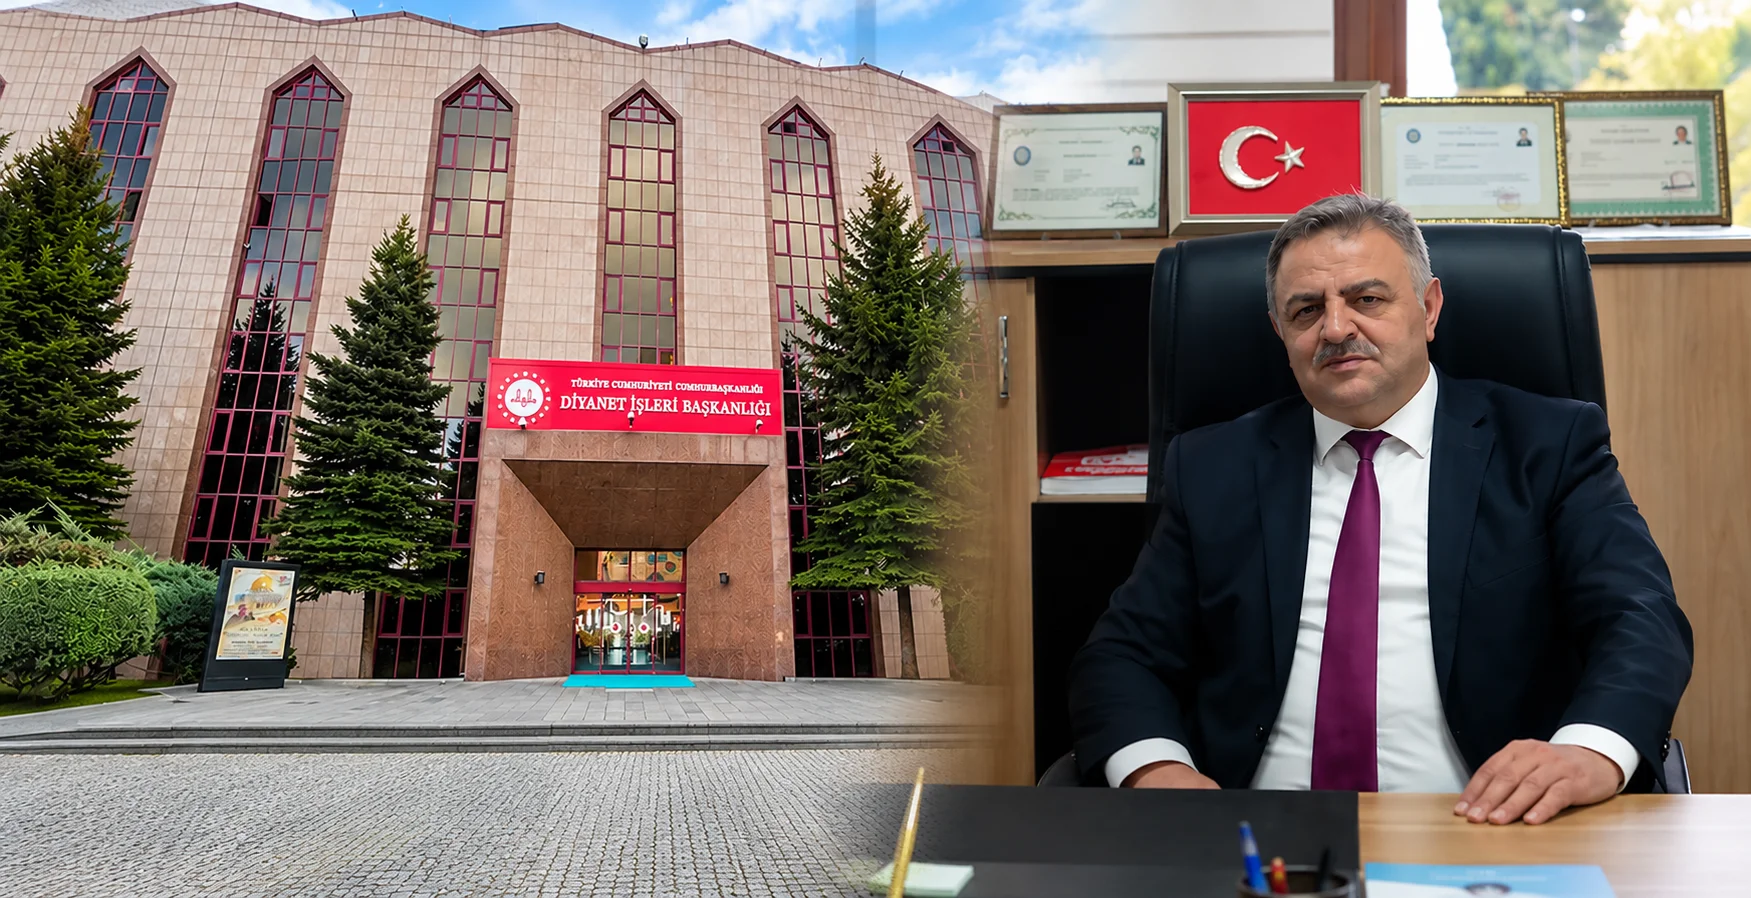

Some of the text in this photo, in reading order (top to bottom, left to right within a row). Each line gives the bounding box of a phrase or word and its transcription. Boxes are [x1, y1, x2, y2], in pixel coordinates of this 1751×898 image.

[571, 377, 763, 396] TÜRKİYE CUMHURİYETİ CUMHURBAŞKANLIĞI
[560, 392, 772, 417] DİYANET İŞLERİ BAŞKANLIĞI
